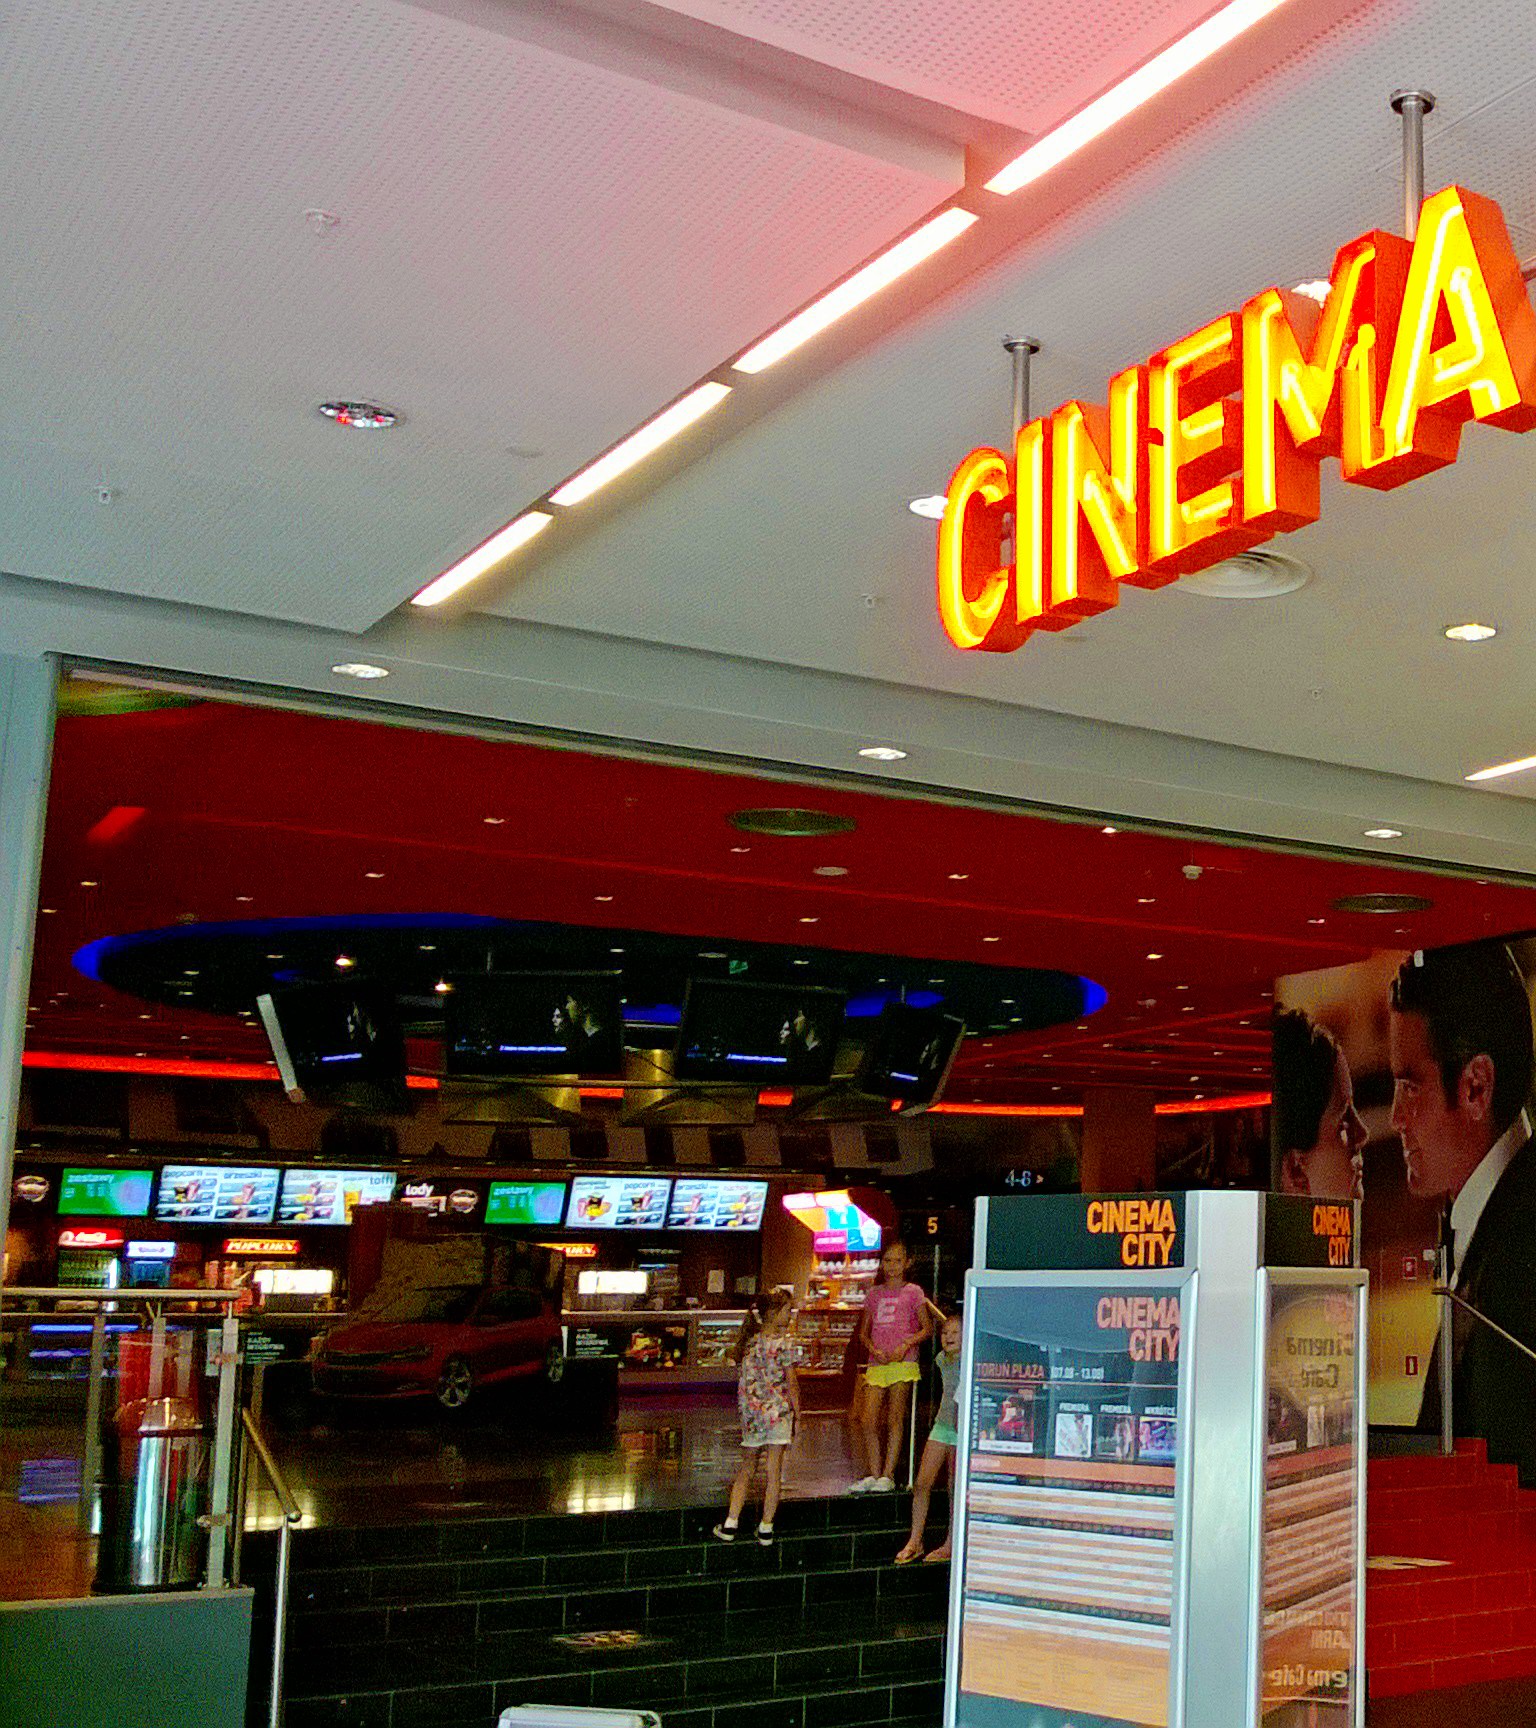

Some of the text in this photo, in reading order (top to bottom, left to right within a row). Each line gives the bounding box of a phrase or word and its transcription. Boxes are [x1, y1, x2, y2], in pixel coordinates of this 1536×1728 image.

[405, 1183, 434, 1198] lody
[927, 1216, 939, 1235] 5
[1087, 1200, 1177, 1234] CINEMA
[1313, 1205, 1351, 1236] CINEMA
[1122, 1232, 1176, 1267] CITY
[1329, 1237, 1351, 1266] CITY
[1097, 1296, 1180, 1329] CINEMA
[1129, 1328, 1179, 1362] CITY
[1010, 1363, 1045, 1379] PLAZA
